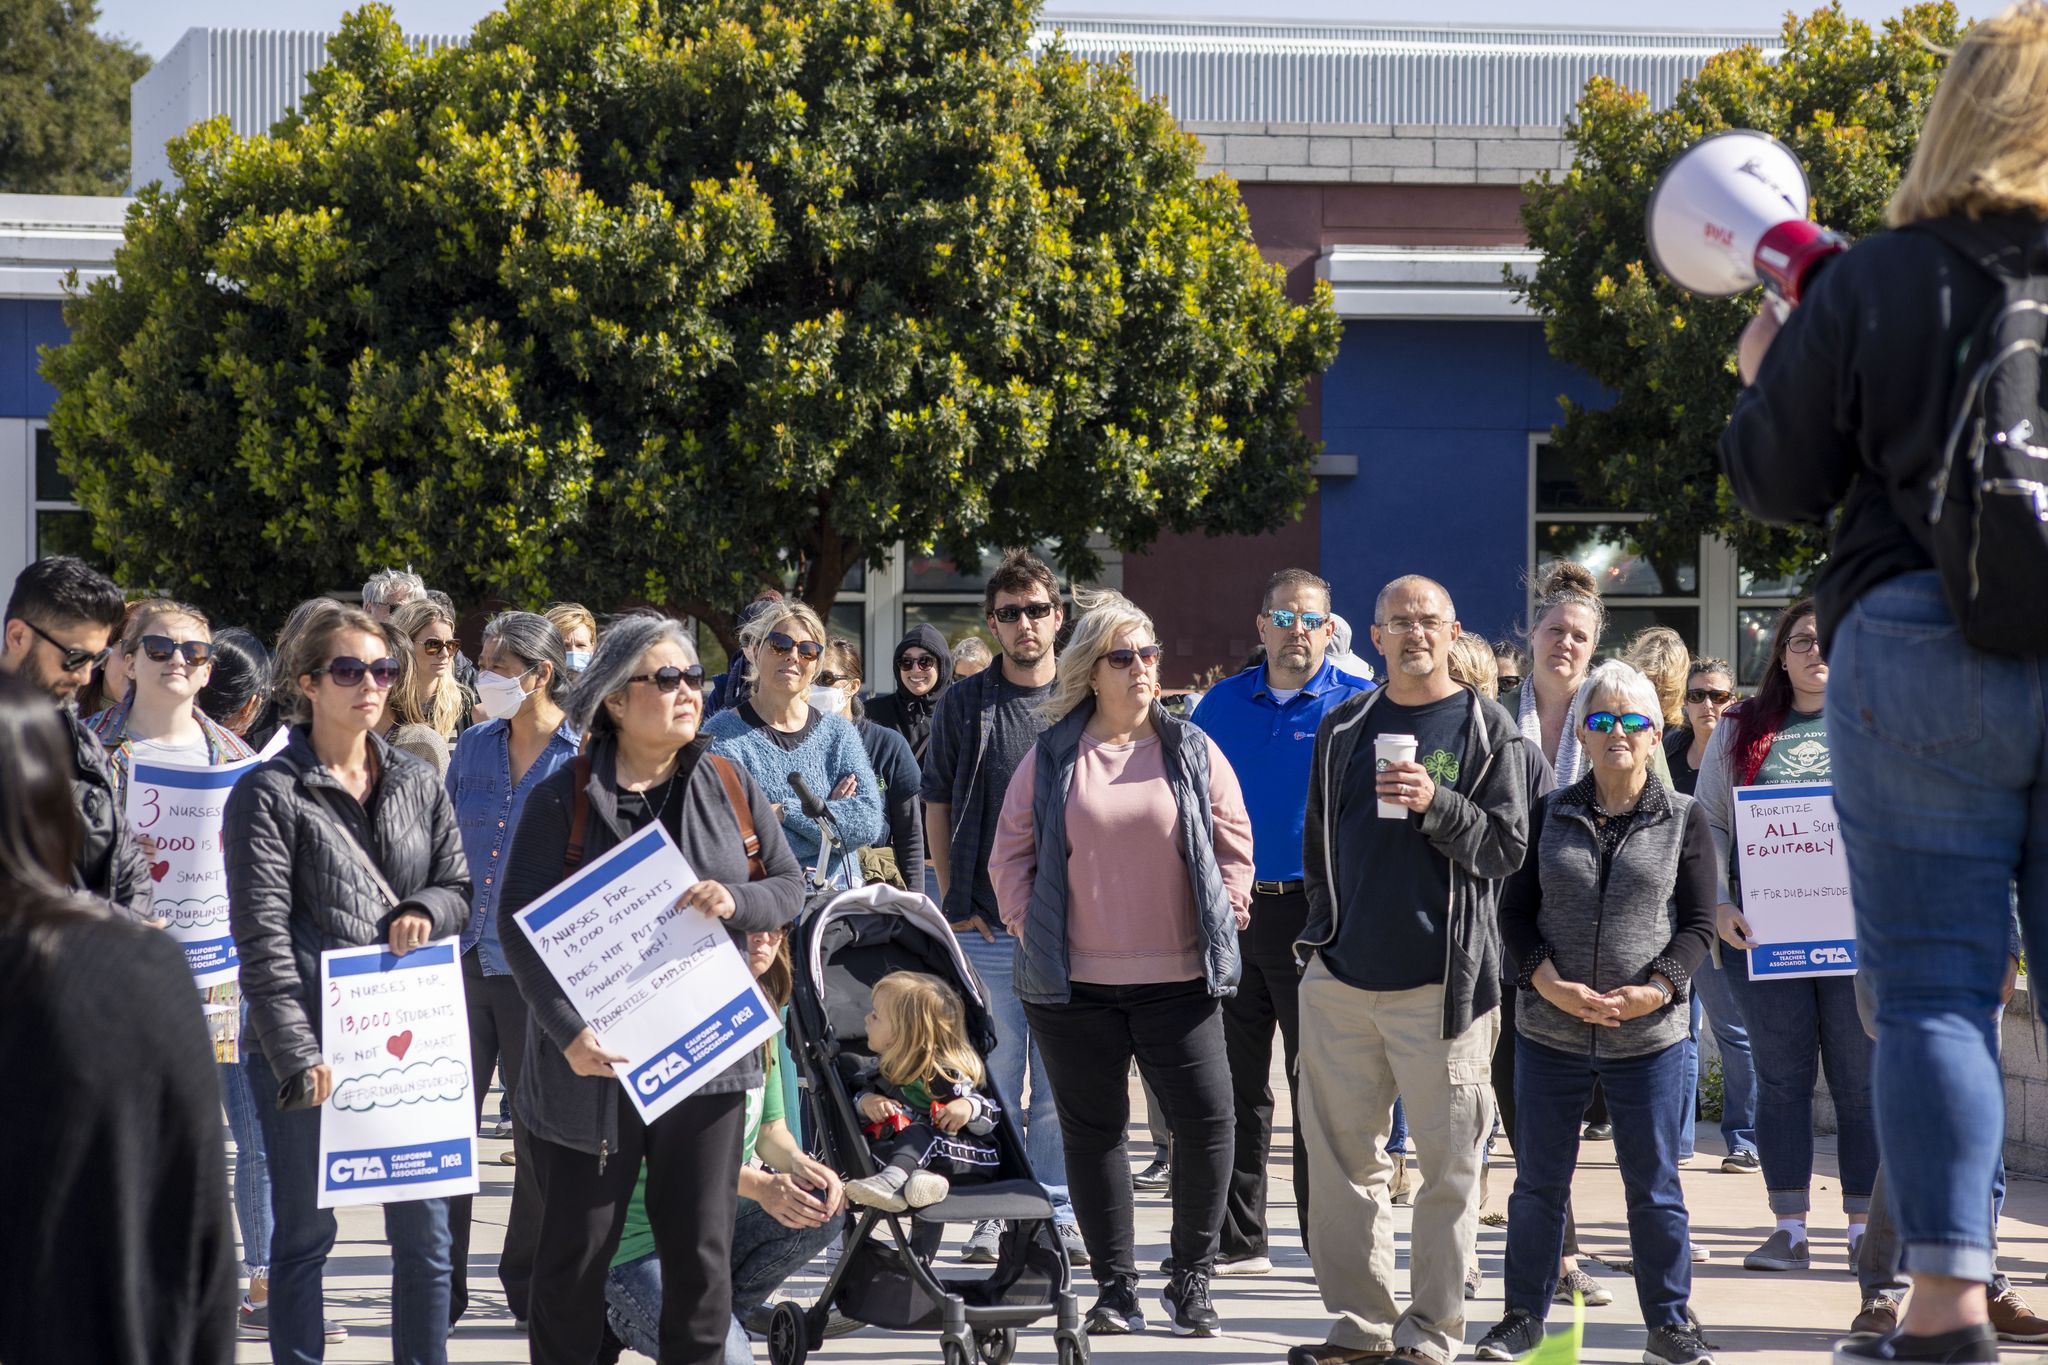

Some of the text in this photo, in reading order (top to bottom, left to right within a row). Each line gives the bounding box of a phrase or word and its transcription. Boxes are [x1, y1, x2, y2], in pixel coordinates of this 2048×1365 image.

[138, 788, 221, 828] 3 NURSES
[1750, 802, 1813, 818] PRIORITIZE
[1764, 822, 1809, 838] ALL
[201, 840, 212, 851] IS
[1746, 838, 1834, 857] EQUITABLY
[176, 869, 224, 883] SMART
[539, 884, 636, 953] 3 NURSES FOR
[563, 879, 672, 958] 13,000 STUDENTS
[184, 944, 223, 955] CALIFORNIA
[567, 960, 599, 987] DOES
[601, 941, 624, 963] NOT
[631, 923, 653, 943] PUT
[1809, 947, 1852, 964] CTA
[1769, 960, 1807, 968] ASSOCIATION
[329, 981, 341, 1007] 3
[350, 980, 407, 999] NURSES
[340, 1004, 455, 1035] 13,000 STUDENTS
[592, 988, 649, 1032] PRIORITIZE
[731, 1006, 754, 1029] nea
[414, 1033, 457, 1053] SMART
[684, 1020, 722, 1050] CALIFORNIA
[689, 1032, 720, 1056] TEACHERS
[332, 1044, 382, 1065] IS NOT
[692, 1029, 735, 1063] ASSOCIATION
[637, 1051, 692, 1095] CTA
[391, 1151, 433, 1162] CALIFORNIA
[391, 1160, 426, 1170] TEACHERS
[440, 1153, 463, 1169] nea
[329, 1156, 387, 1183] CTA
[390, 1166, 439, 1178] ASSOCIATION
